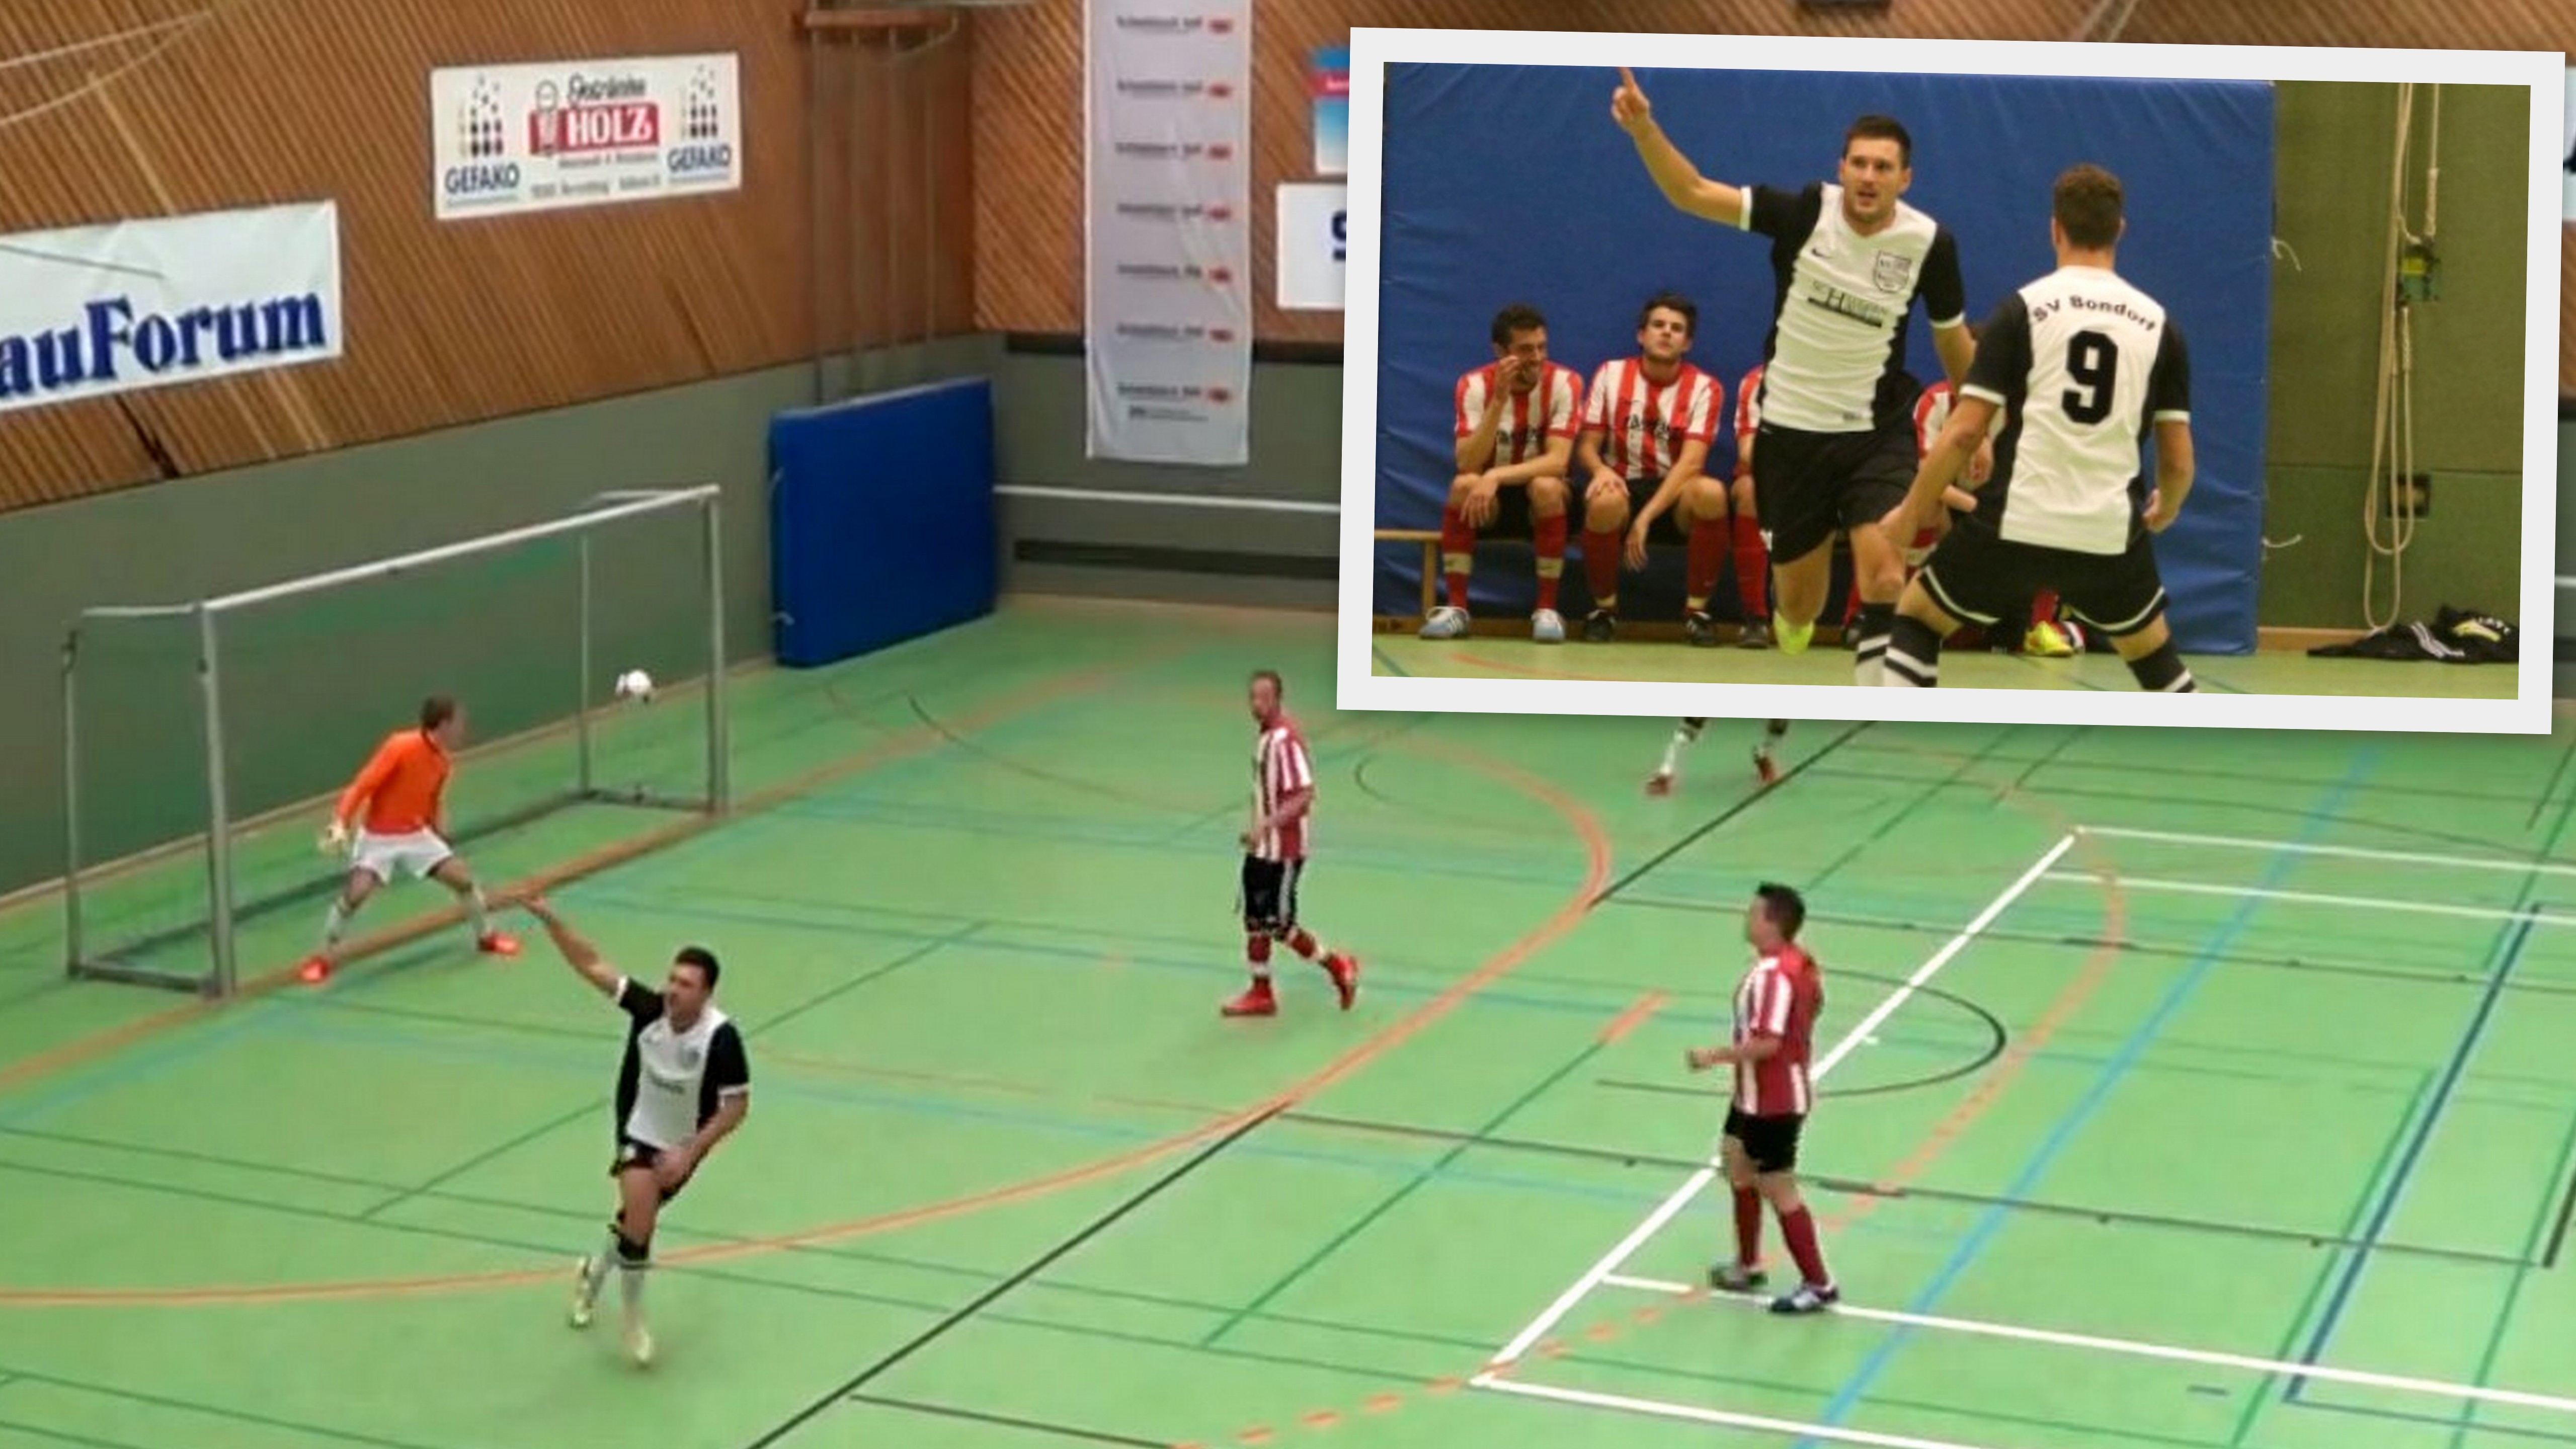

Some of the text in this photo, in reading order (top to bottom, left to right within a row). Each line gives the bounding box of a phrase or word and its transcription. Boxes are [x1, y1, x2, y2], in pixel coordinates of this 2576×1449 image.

[567, 106, 653, 147] HOLZ
[667, 143, 732, 173] GEFAKO
[445, 162, 521, 195] GEFAKO
[2033, 299, 2061, 322] SV
[0, 292, 325, 396] auForum
[2061, 330, 2119, 426] 9
